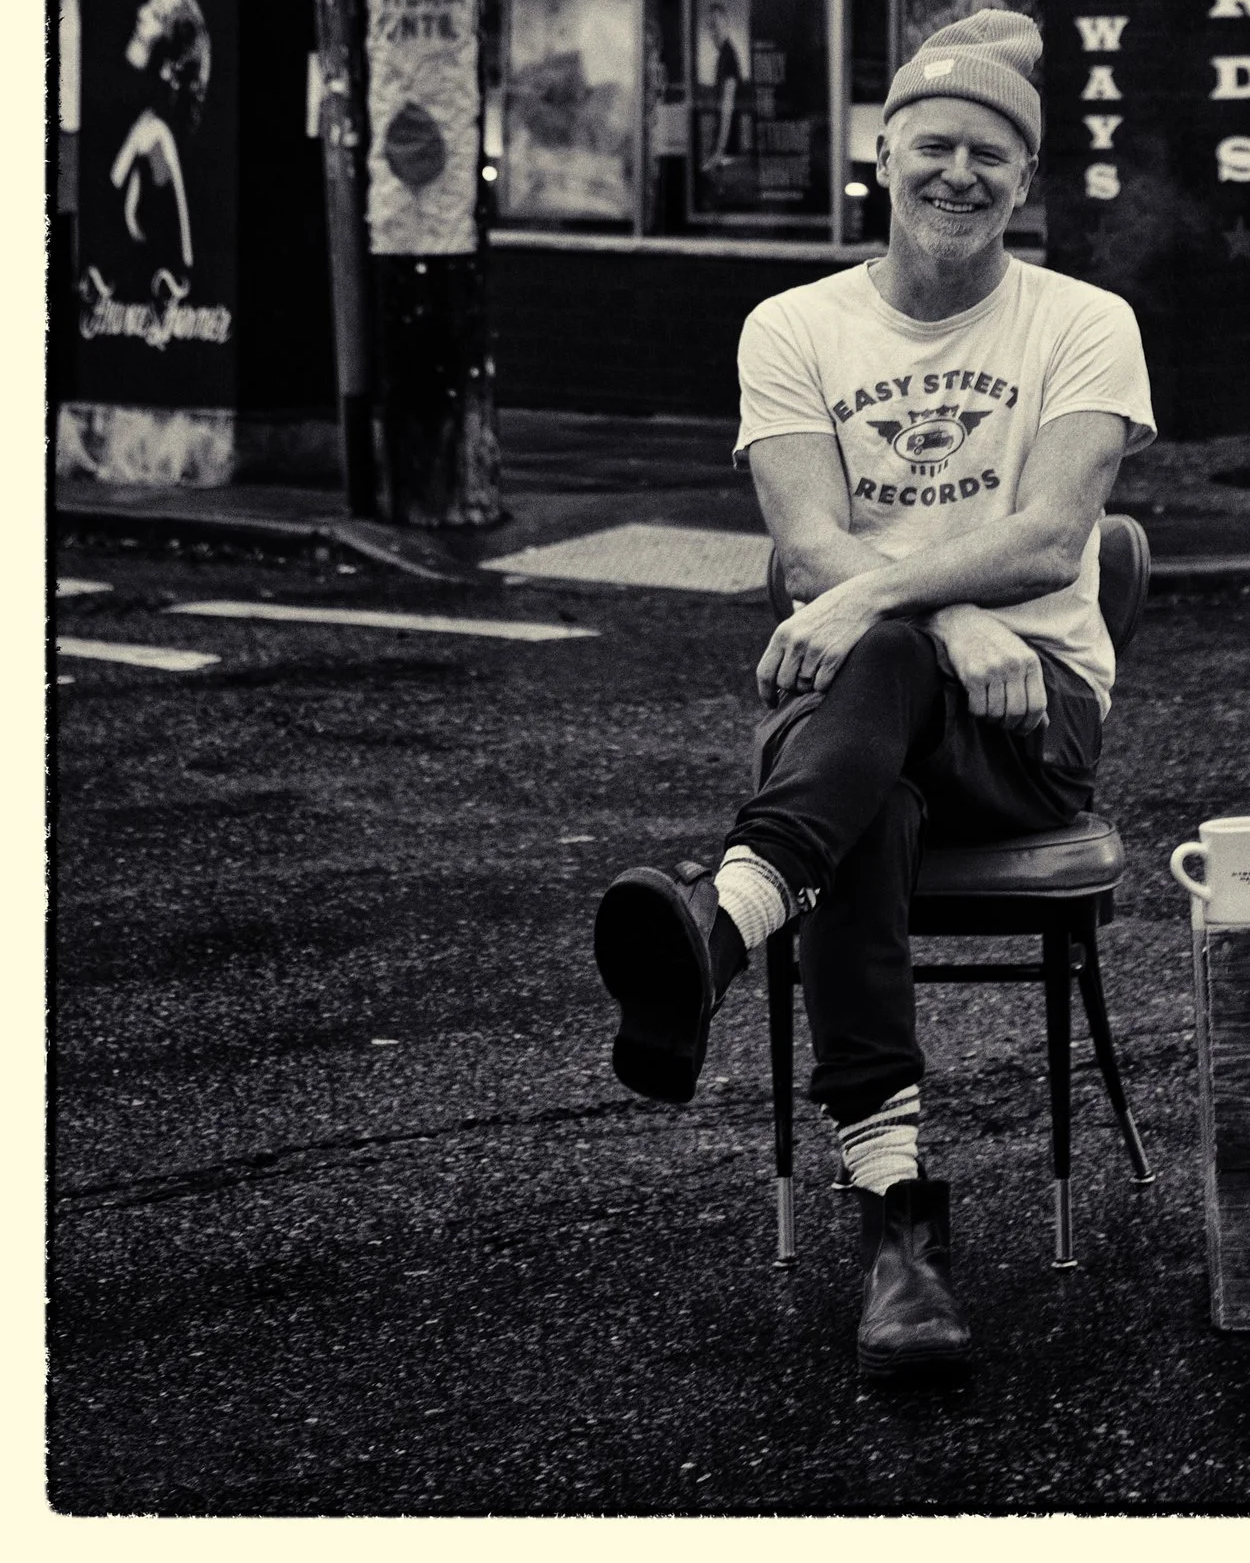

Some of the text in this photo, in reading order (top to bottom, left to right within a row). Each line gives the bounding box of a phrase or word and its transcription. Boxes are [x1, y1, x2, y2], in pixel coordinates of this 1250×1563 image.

[1074, 15, 1129, 200] WAYS
[832, 369, 1020, 424] EASY STREET
[853, 468, 1001, 507] RECORDS
